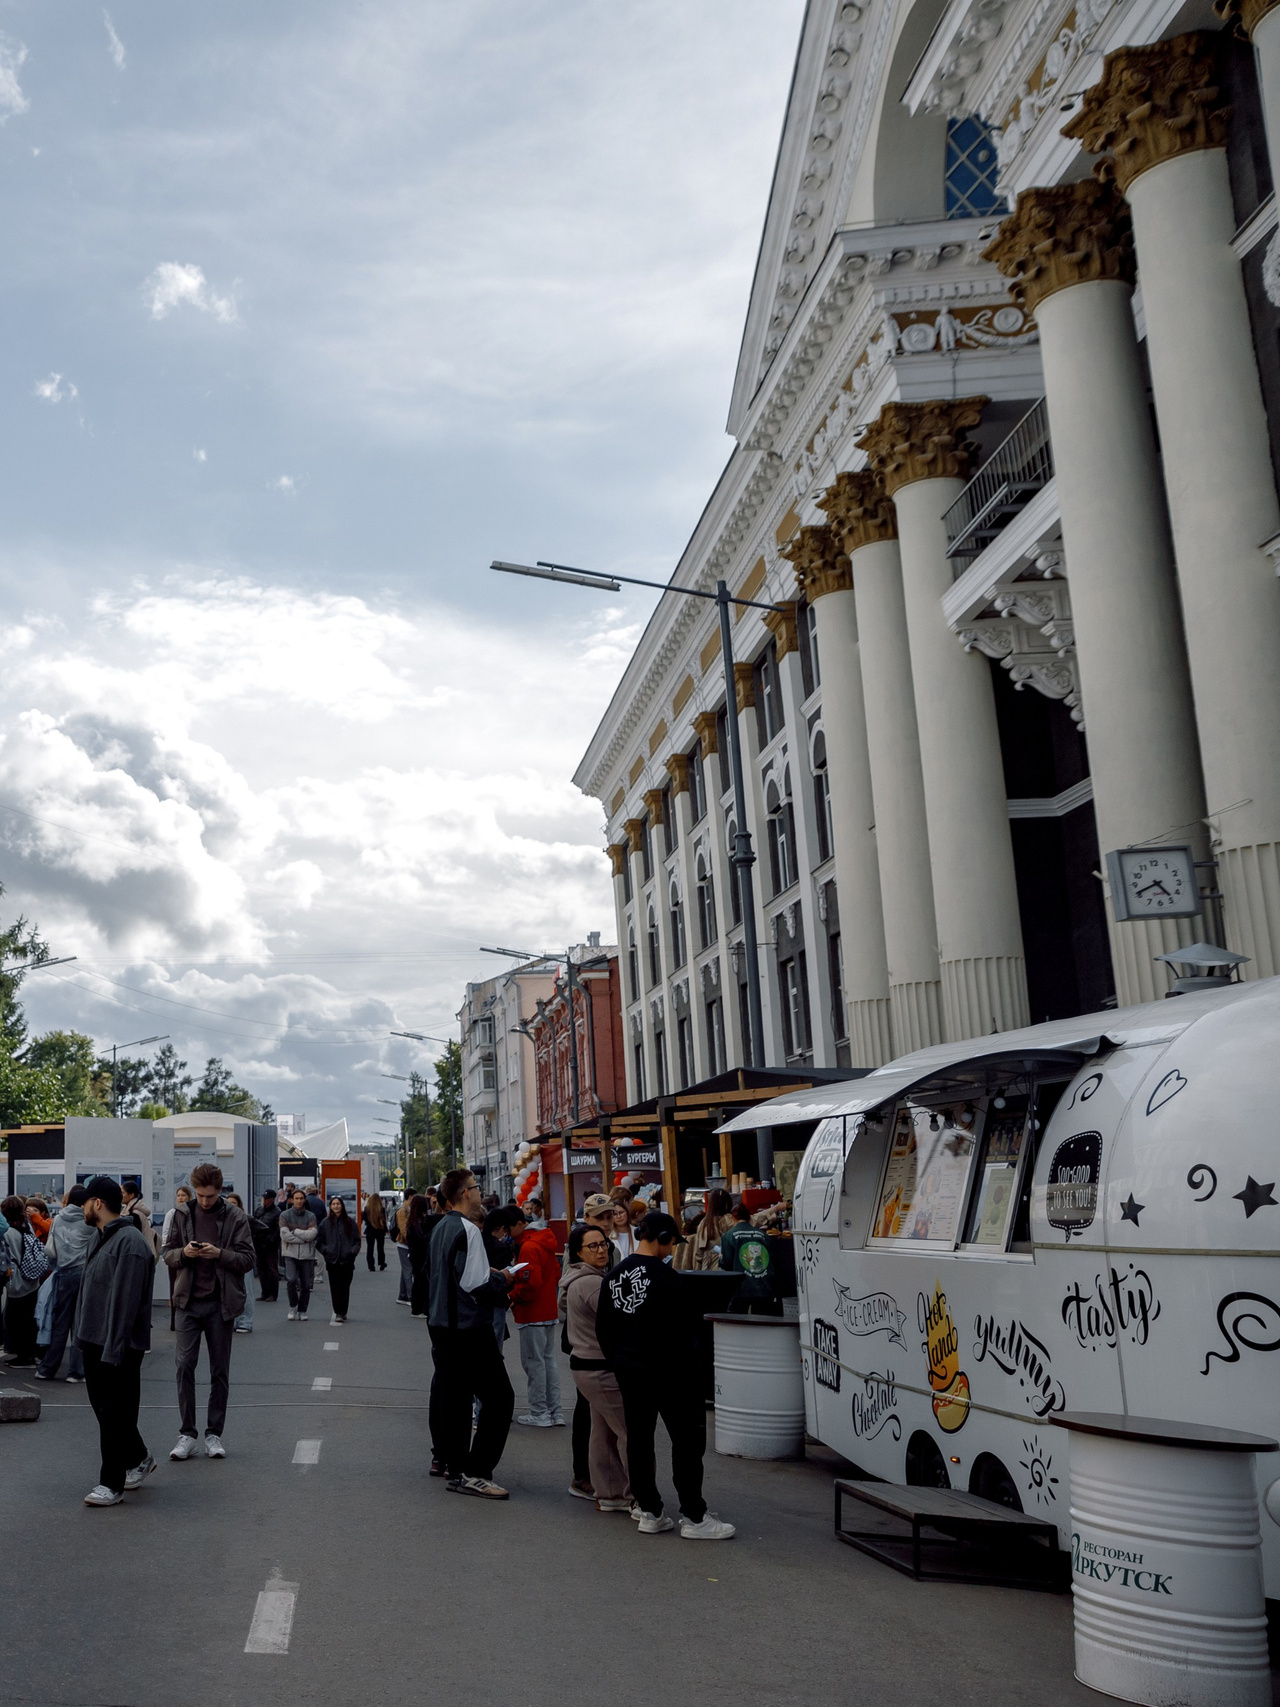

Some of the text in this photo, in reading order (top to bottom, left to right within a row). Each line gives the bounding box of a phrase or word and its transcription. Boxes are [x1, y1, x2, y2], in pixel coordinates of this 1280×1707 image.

[570, 1155, 596, 1166] ШАУРМА
[626, 1152, 657, 1164] БУРГЕРЫ
[1053, 1186, 1091, 1209] TO SEE YOU!
[846, 1298, 891, 1328] ICE CREAM
[917, 1291, 947, 1338] Hot
[1061, 1267, 1153, 1346] tasty
[815, 1322, 838, 1358] TAKE
[817, 1354, 839, 1388] AWAY
[1083, 1541, 1144, 1564] РЕСТОРАН
